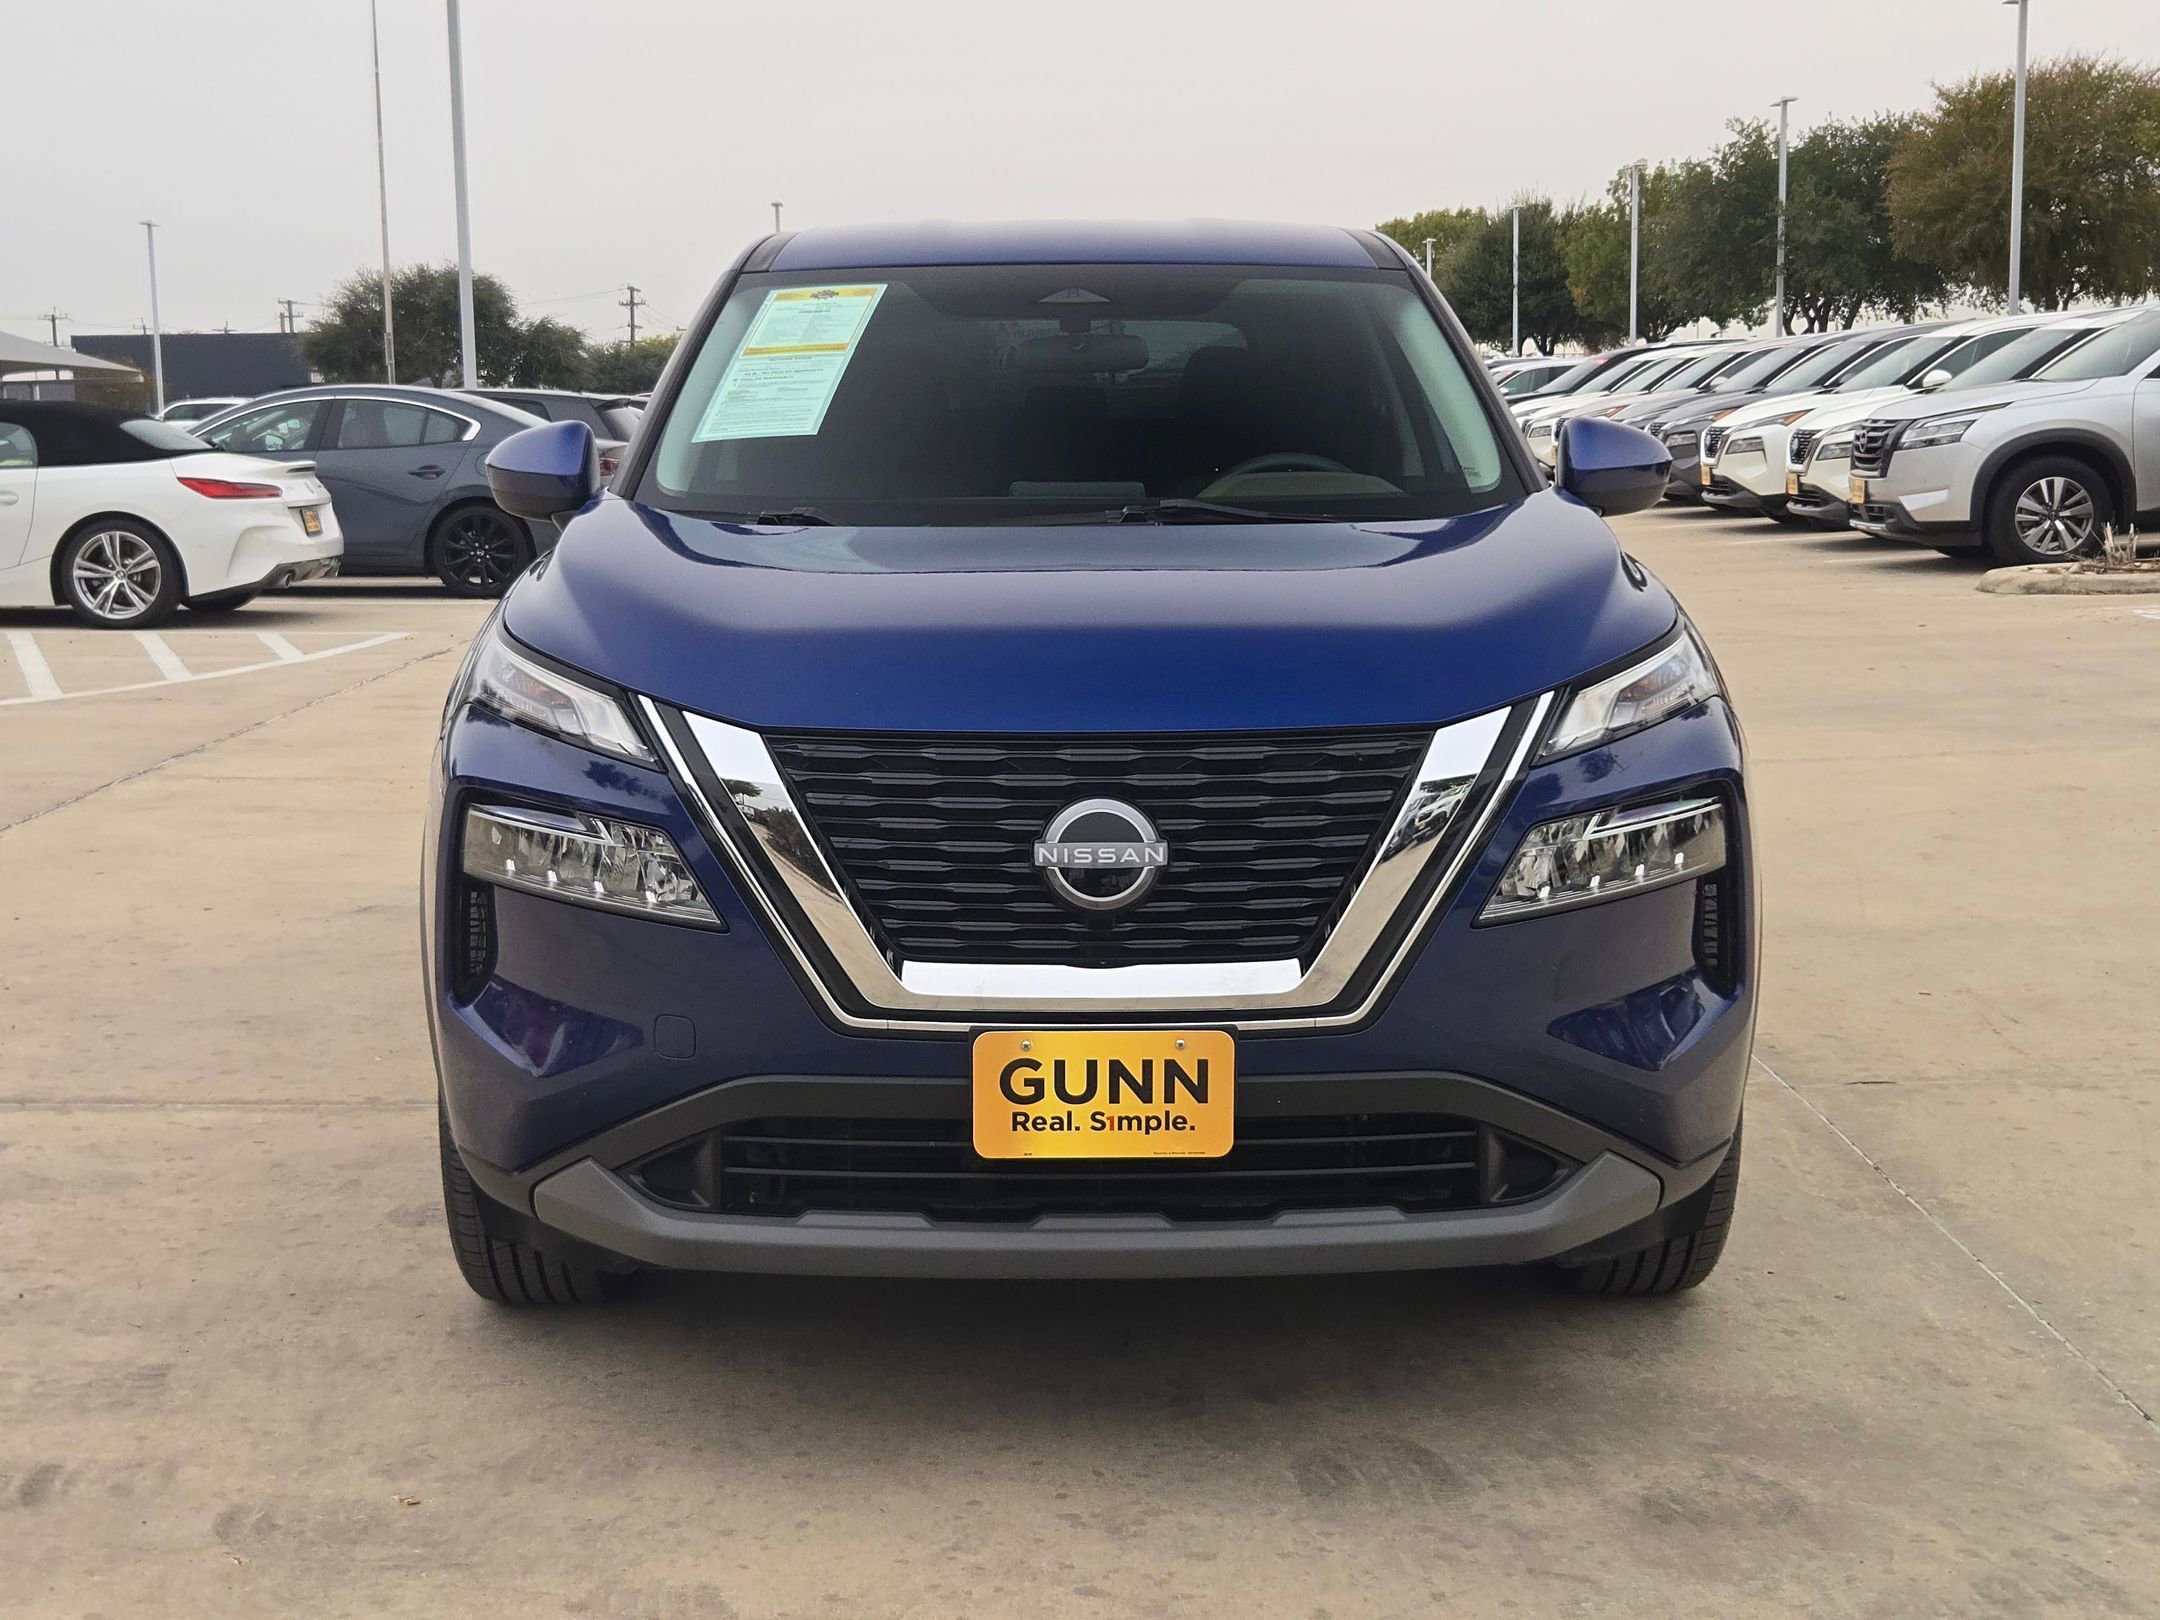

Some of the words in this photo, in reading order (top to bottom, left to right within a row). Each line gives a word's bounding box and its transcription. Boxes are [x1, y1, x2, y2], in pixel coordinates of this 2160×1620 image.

[1037, 846, 1164, 863] NISSAN
[999, 1058, 1209, 1105] GUNN
[1012, 1111, 1080, 1132] Real.
